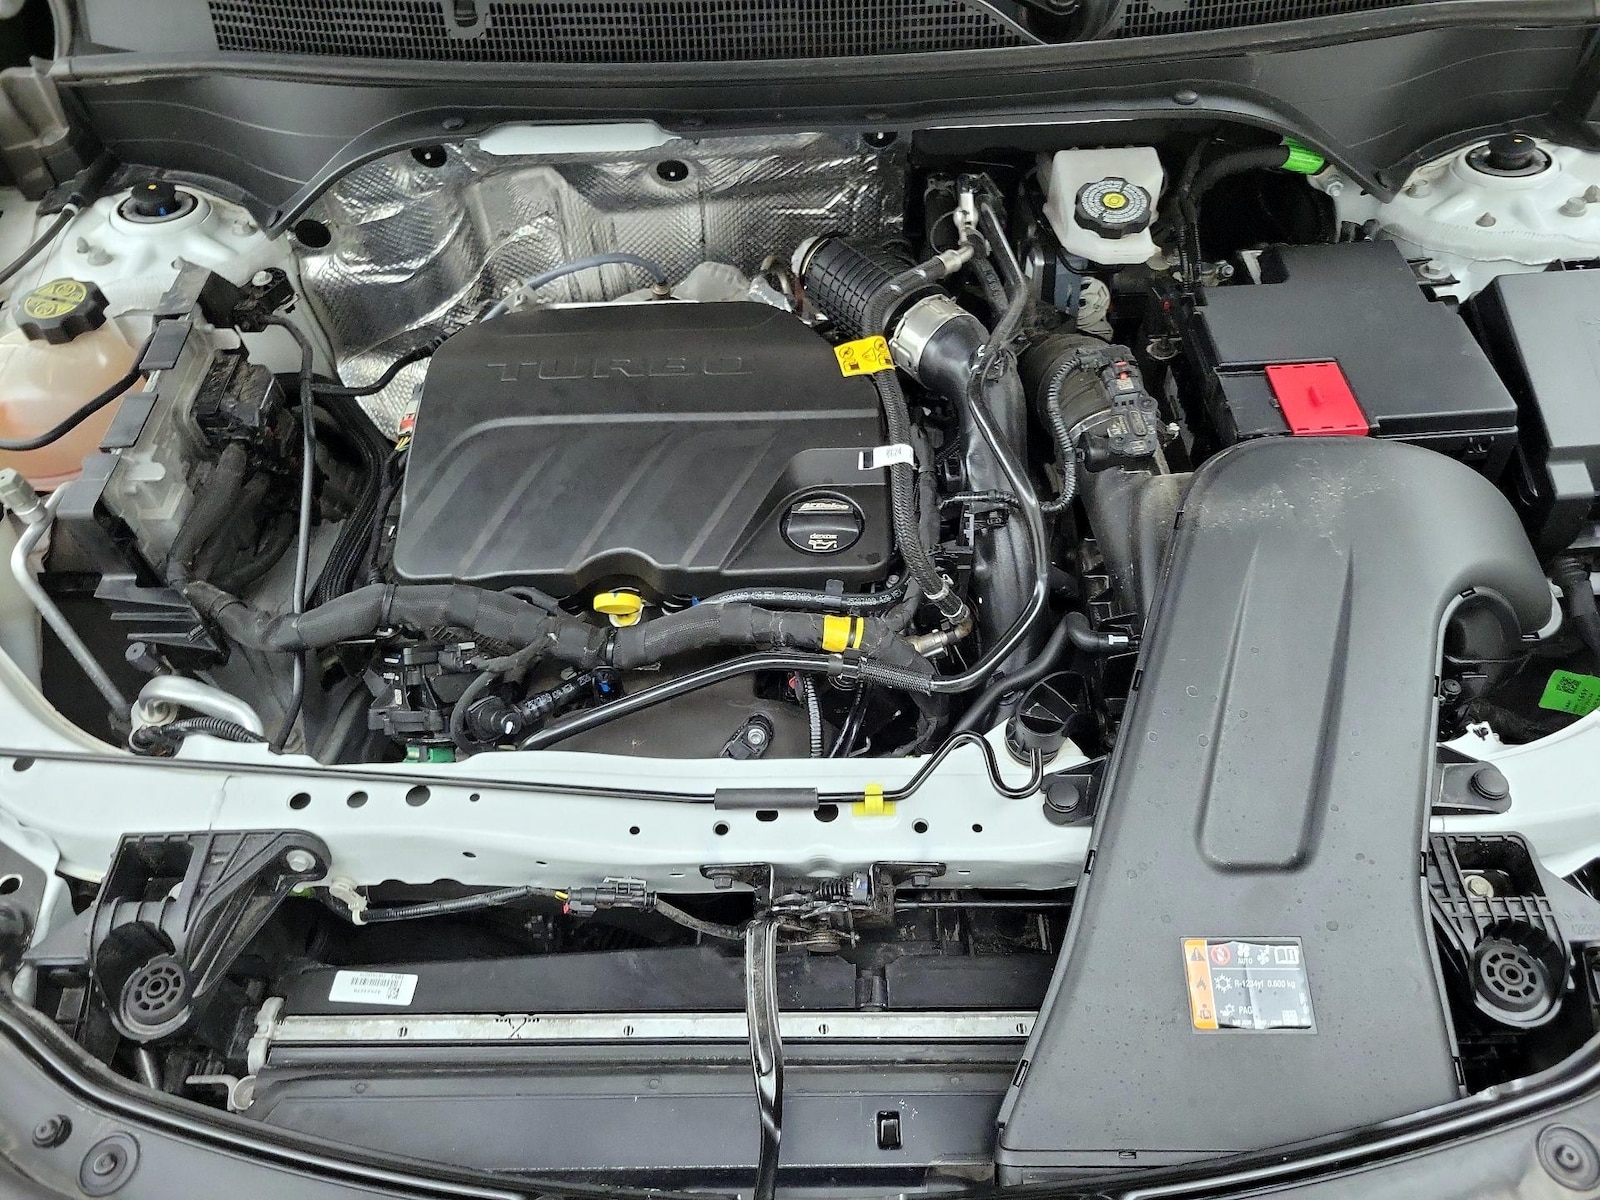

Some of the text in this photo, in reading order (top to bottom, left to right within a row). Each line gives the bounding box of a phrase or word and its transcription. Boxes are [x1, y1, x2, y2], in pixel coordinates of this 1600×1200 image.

[486, 354, 754, 382] TURBO
[1237, 957, 1253, 965] AUTO
[1287, 979, 1296, 990] kg
